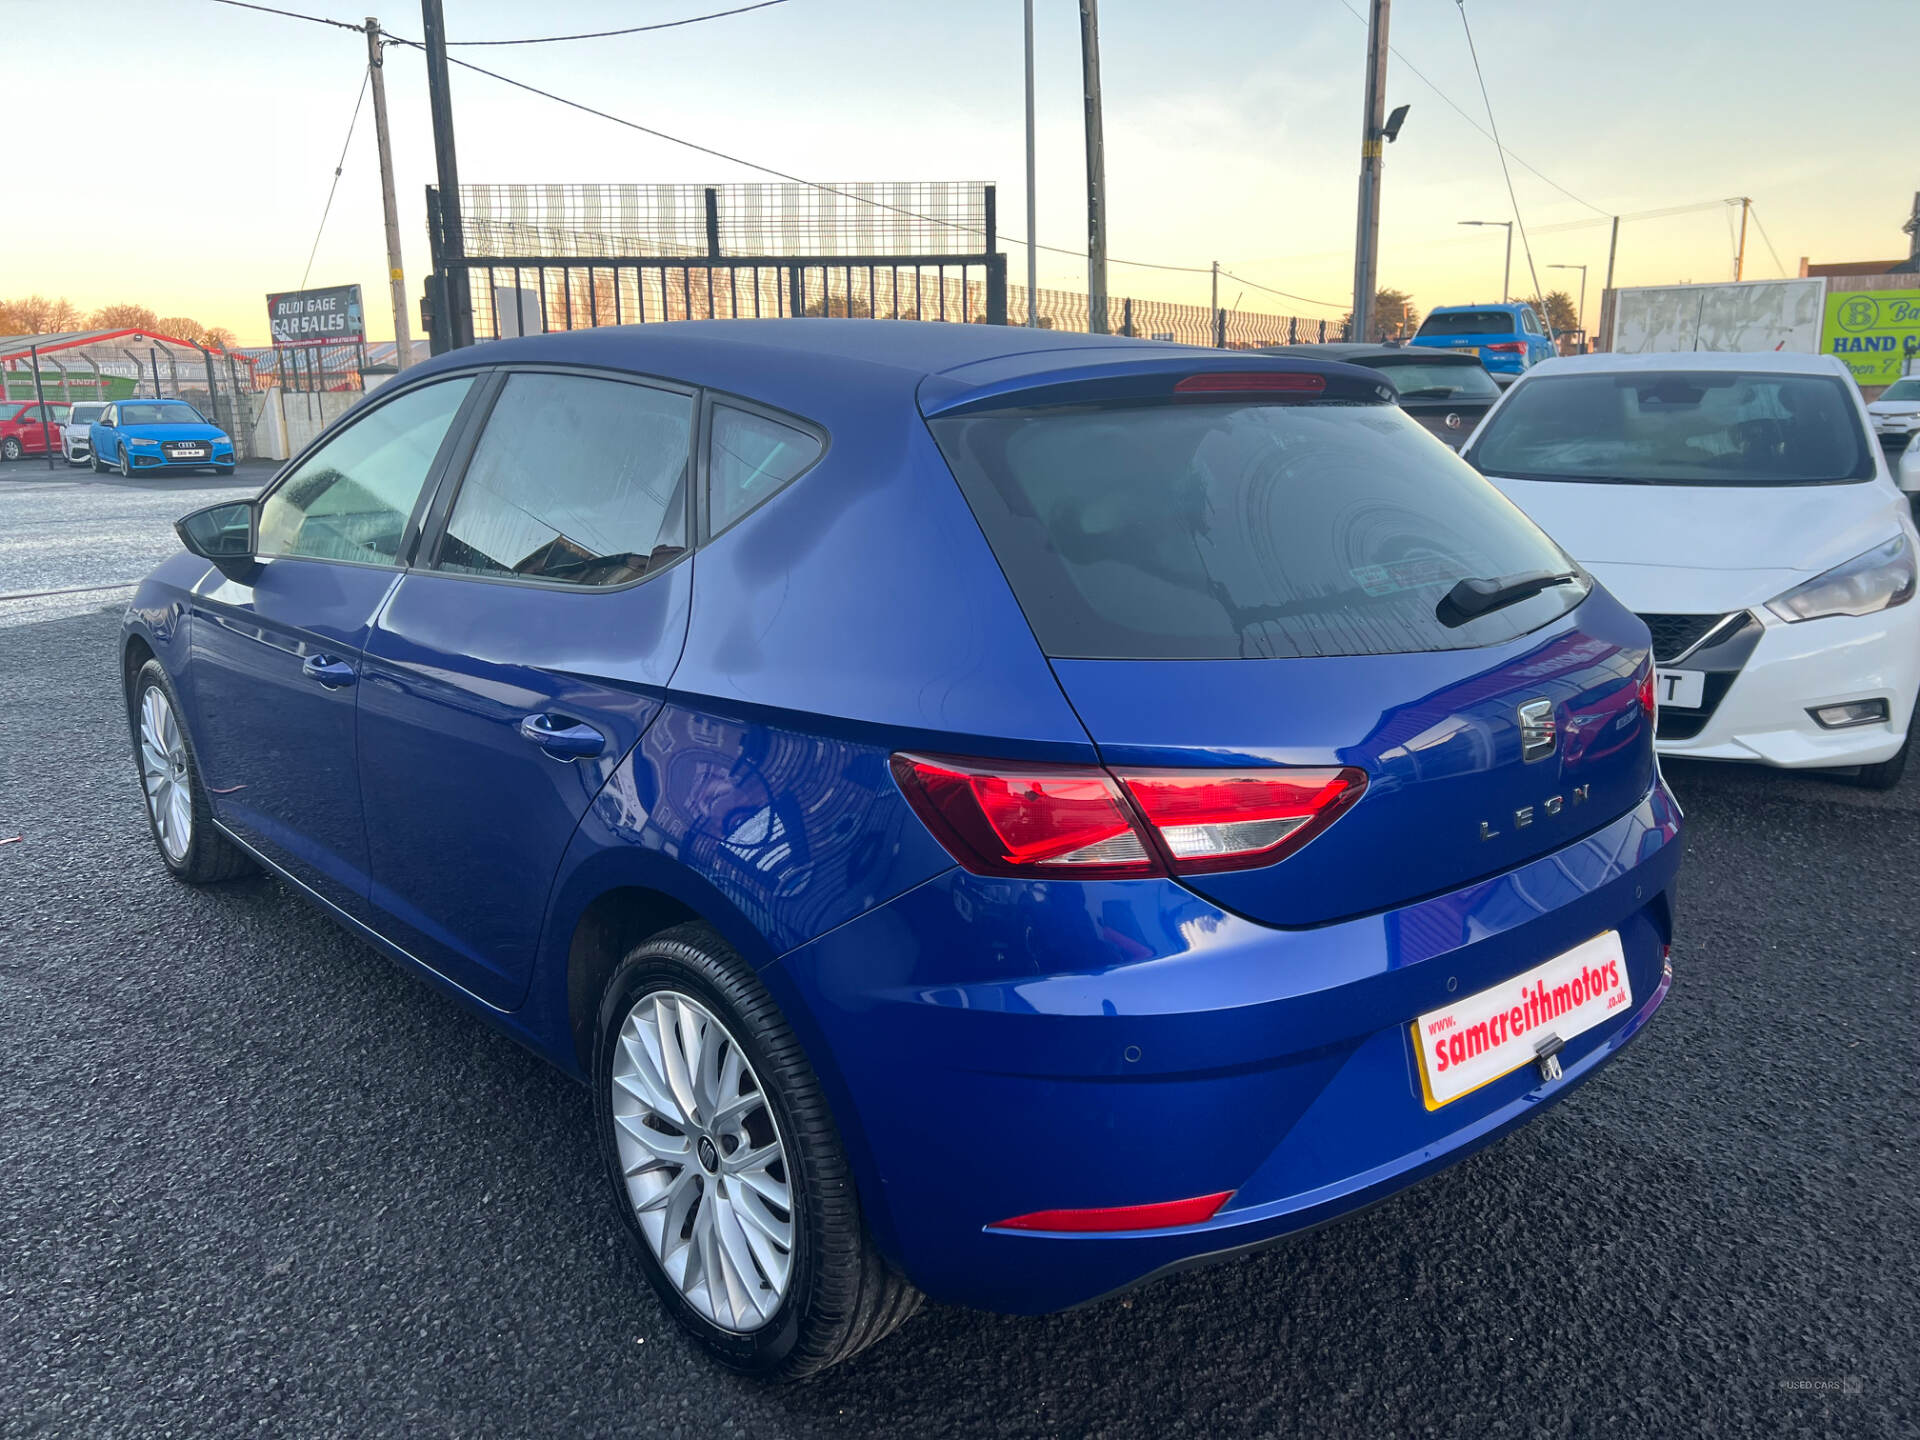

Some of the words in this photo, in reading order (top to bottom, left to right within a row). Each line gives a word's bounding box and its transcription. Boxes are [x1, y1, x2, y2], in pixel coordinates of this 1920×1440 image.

[278, 301, 304, 315] RUDI
[307, 297, 336, 312] GAGE
[1832, 336, 1897, 353] HAND
[1480, 784, 1590, 842] LEON
[1606, 987, 1627, 1010] .co.uk
[1428, 1015, 1457, 1036] www.
[1435, 959, 1619, 1072] samcreithmotors
